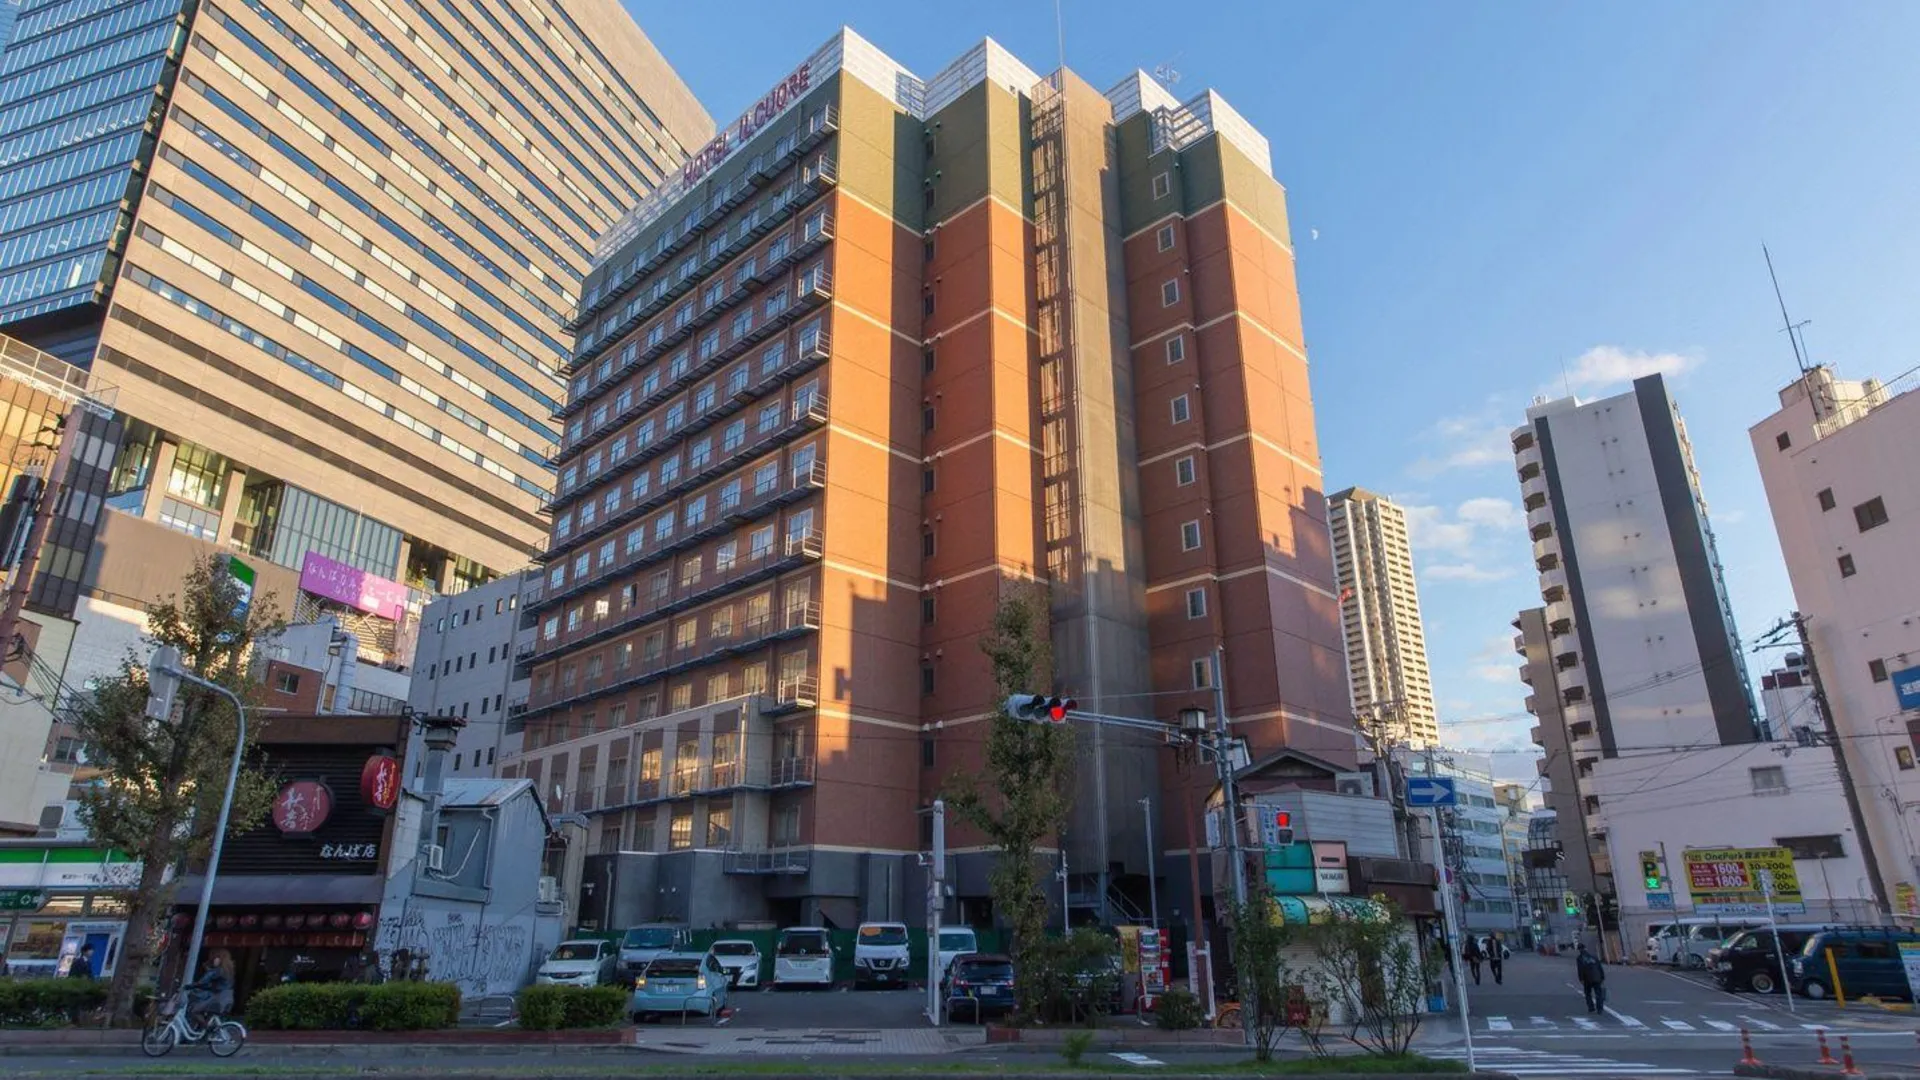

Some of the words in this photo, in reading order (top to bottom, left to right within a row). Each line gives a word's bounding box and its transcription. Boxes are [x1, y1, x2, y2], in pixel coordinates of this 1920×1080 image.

[682, 131, 730, 191] HOTEL
[738, 113, 753, 144] IL
[754, 61, 812, 129] CUORE
[320, 843, 377, 859] なんば店
[1704, 851, 1743, 861] OnePark
